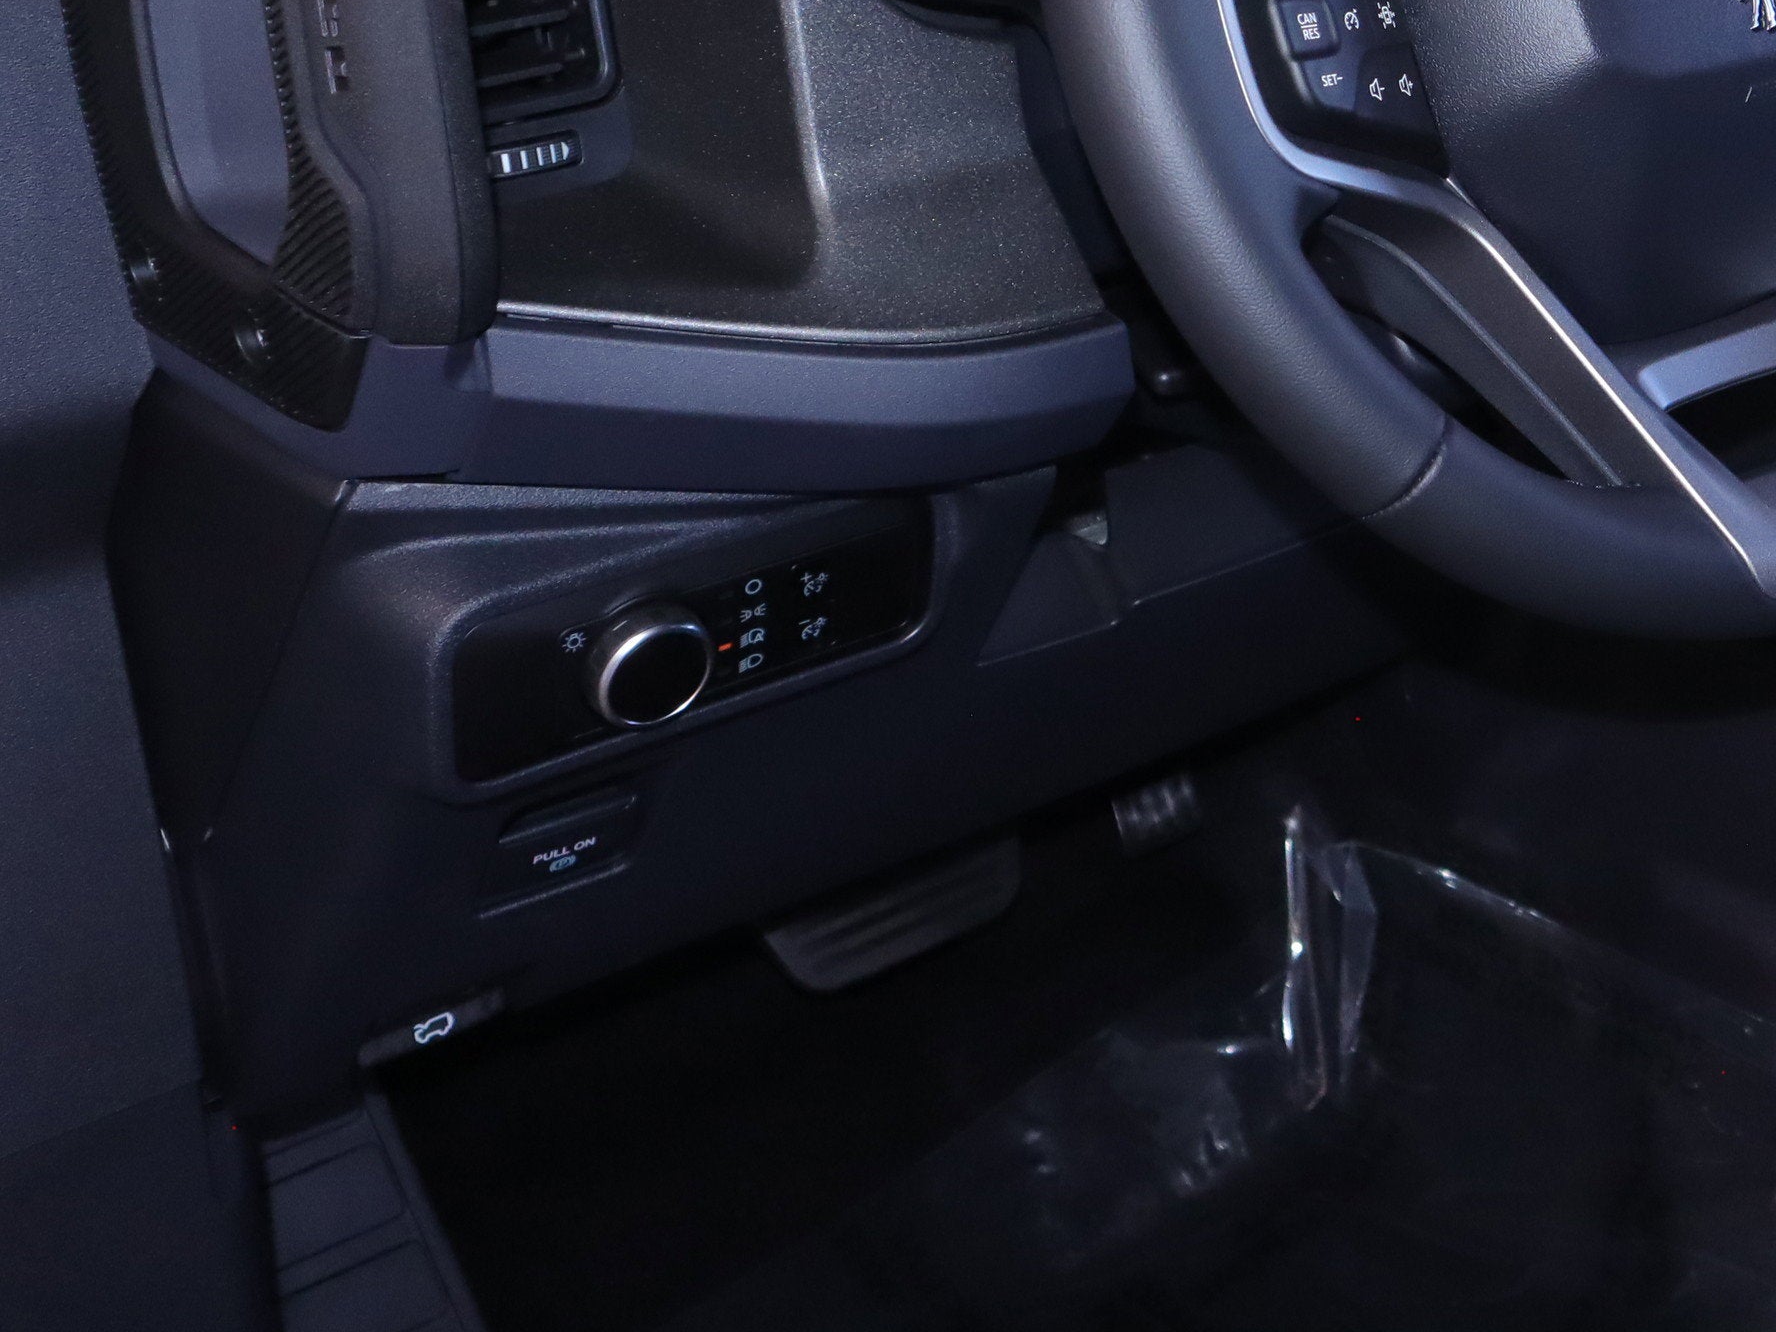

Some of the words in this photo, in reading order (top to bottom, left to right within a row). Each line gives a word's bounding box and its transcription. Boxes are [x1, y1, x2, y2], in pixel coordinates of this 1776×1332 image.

[1296, 12, 1318, 26] CAN
[1302, 28, 1321, 41] RES
[1320, 73, 1344, 87] SET-
[532, 846, 571, 866] PULL
[573, 836, 597, 852] ON
